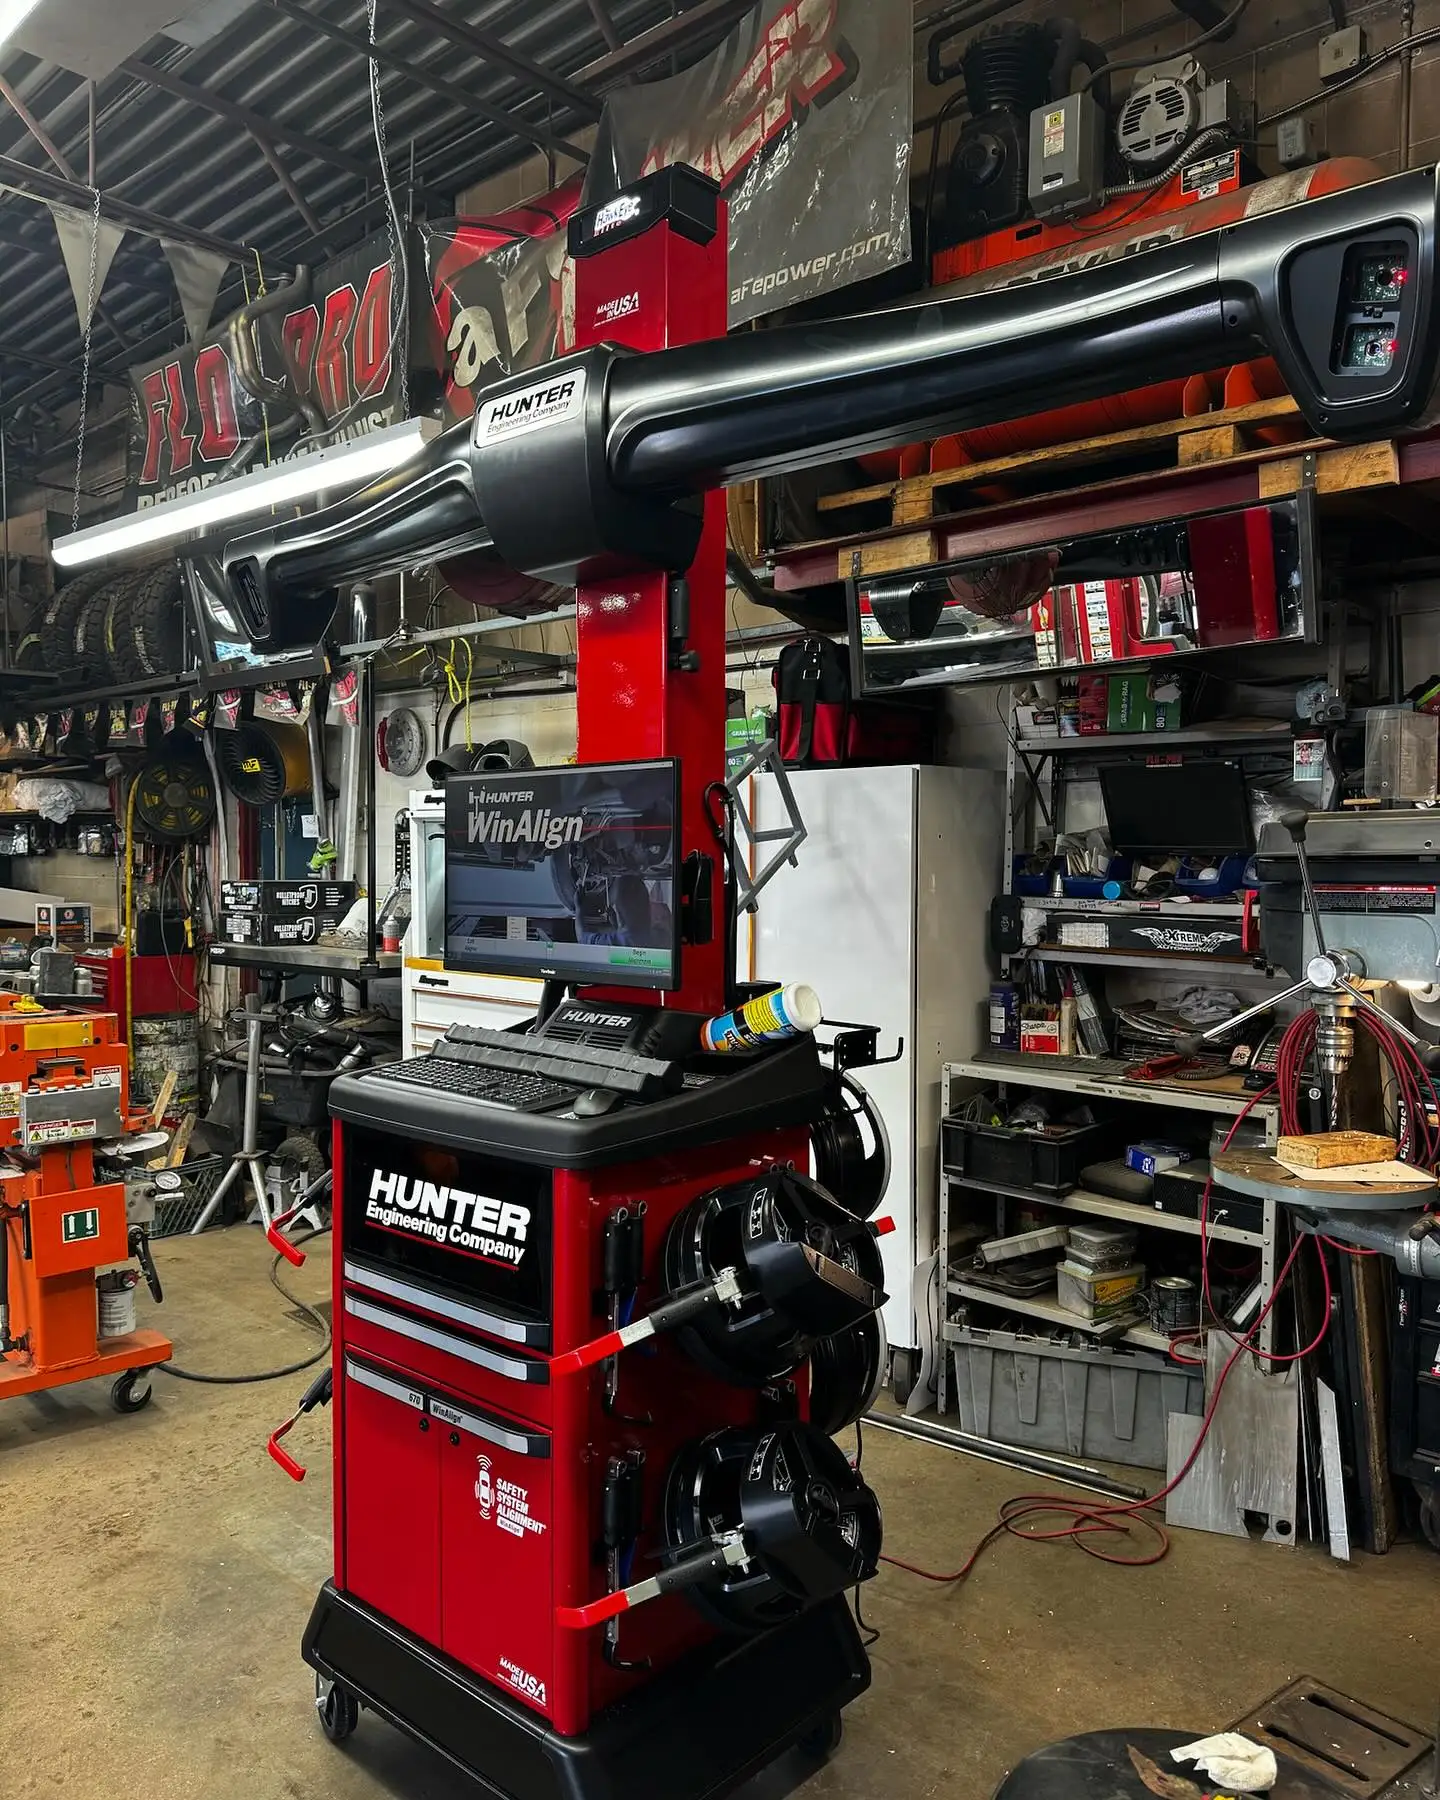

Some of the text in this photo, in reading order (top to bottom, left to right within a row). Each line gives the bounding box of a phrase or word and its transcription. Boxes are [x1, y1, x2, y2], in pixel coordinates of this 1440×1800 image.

[596, 300, 615, 314] MADE
[613, 291, 639, 316] USA
[490, 380, 575, 423] HUNTER
[487, 400, 571, 433] Engineering Company
[1156, 716, 1165, 728] 80
[486, 790, 534, 804] HUNTER
[562, 1010, 632, 1028] HUNTER
[369, 1169, 531, 1241] HUNTER
[366, 1200, 525, 1265] Engineering Company
[408, 1393, 421, 1405] 670
[496, 1478, 528, 1501] SAFETY
[496, 1491, 529, 1515] SYSTEM
[496, 1504, 543, 1535] ALIGNMENT
[499, 1657, 521, 1676] MADE
[518, 1670, 547, 1703] USA
